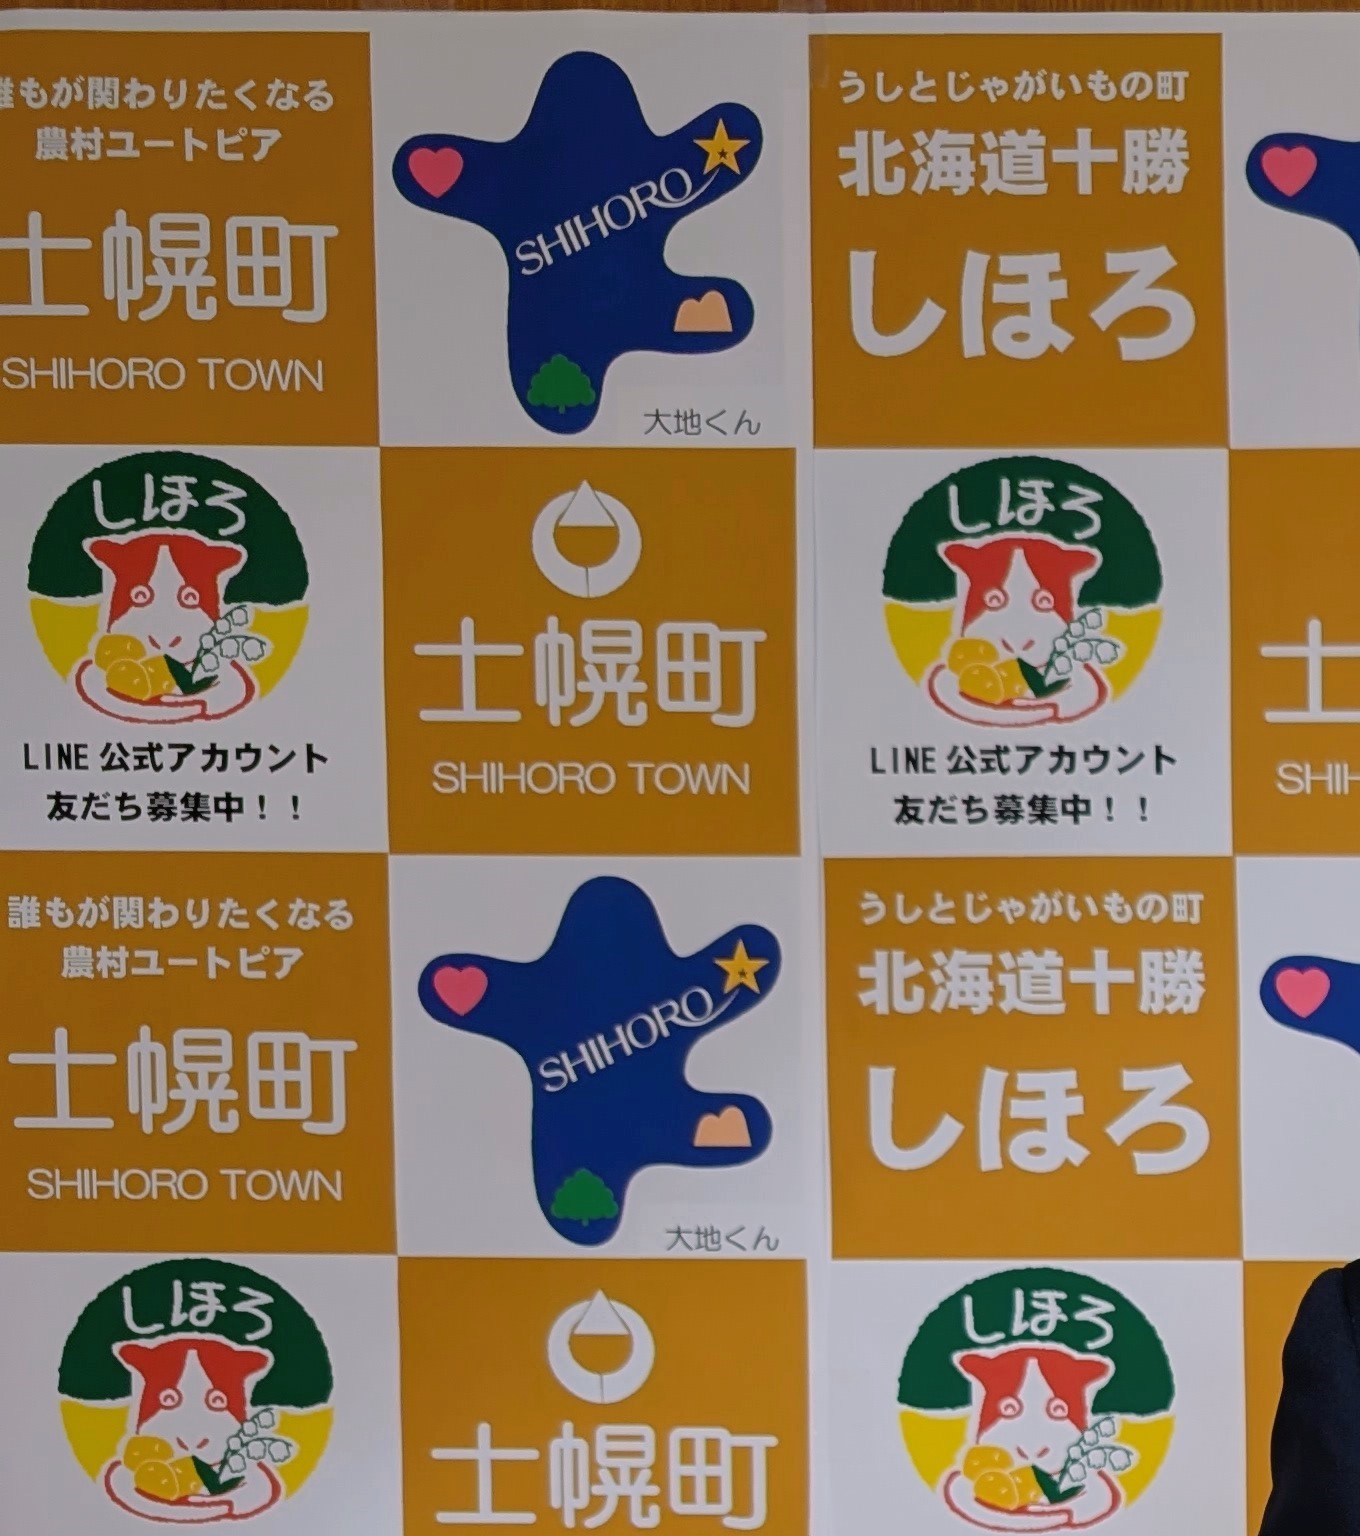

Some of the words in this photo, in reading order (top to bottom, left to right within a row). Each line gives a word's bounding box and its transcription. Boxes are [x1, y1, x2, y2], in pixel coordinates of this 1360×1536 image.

[840, 69, 1189, 103] うしとじゃがいもの町
[36, 126, 281, 161] 農村ユートピア
[839, 127, 1189, 196] 北海道十勝
[515, 167, 695, 277] SHIHORO
[0, 209, 338, 323] 士幌町
[850, 245, 1195, 360] しほろ
[3, 357, 185, 389] SHIHORO
[198, 358, 323, 391] TOWN
[644, 409, 760, 435] 大地くん
[91, 473, 249, 534] しほろ
[947, 478, 1105, 539] しほろ
[414, 615, 767, 727] 士幌町
[24, 744, 88, 770] LINE
[100, 742, 327, 773] 公式アカウント
[433, 762, 616, 794] SHIHORO
[628, 762, 749, 794] TOWN
[871, 747, 936, 773] LINE
[947, 745, 1175, 774] 公式アカウント
[47, 791, 299, 822] 友だち募集中！！
[894, 794, 1146, 824] 友だち募集中！！
[8, 895, 353, 930] 誰もが関わりたくなる
[861, 891, 1204, 924] うしとじゃがいもの町
[61, 945, 303, 979] 農村ユートピア
[859, 948, 1205, 1014] 北海道十勝
[539, 987, 714, 1096] SHIHORO
[8, 1025, 358, 1135] 士幌町
[869, 1063, 1210, 1174] しほろ
[28, 1169, 208, 1199] SHIHORO
[220, 1169, 341, 1200] TOWN
[666, 1226, 779, 1251] 大地くん
[121, 1280, 276, 1342] しほろ
[961, 1287, 1119, 1352] しほろ
[431, 1421, 778, 1530] 士幌町
